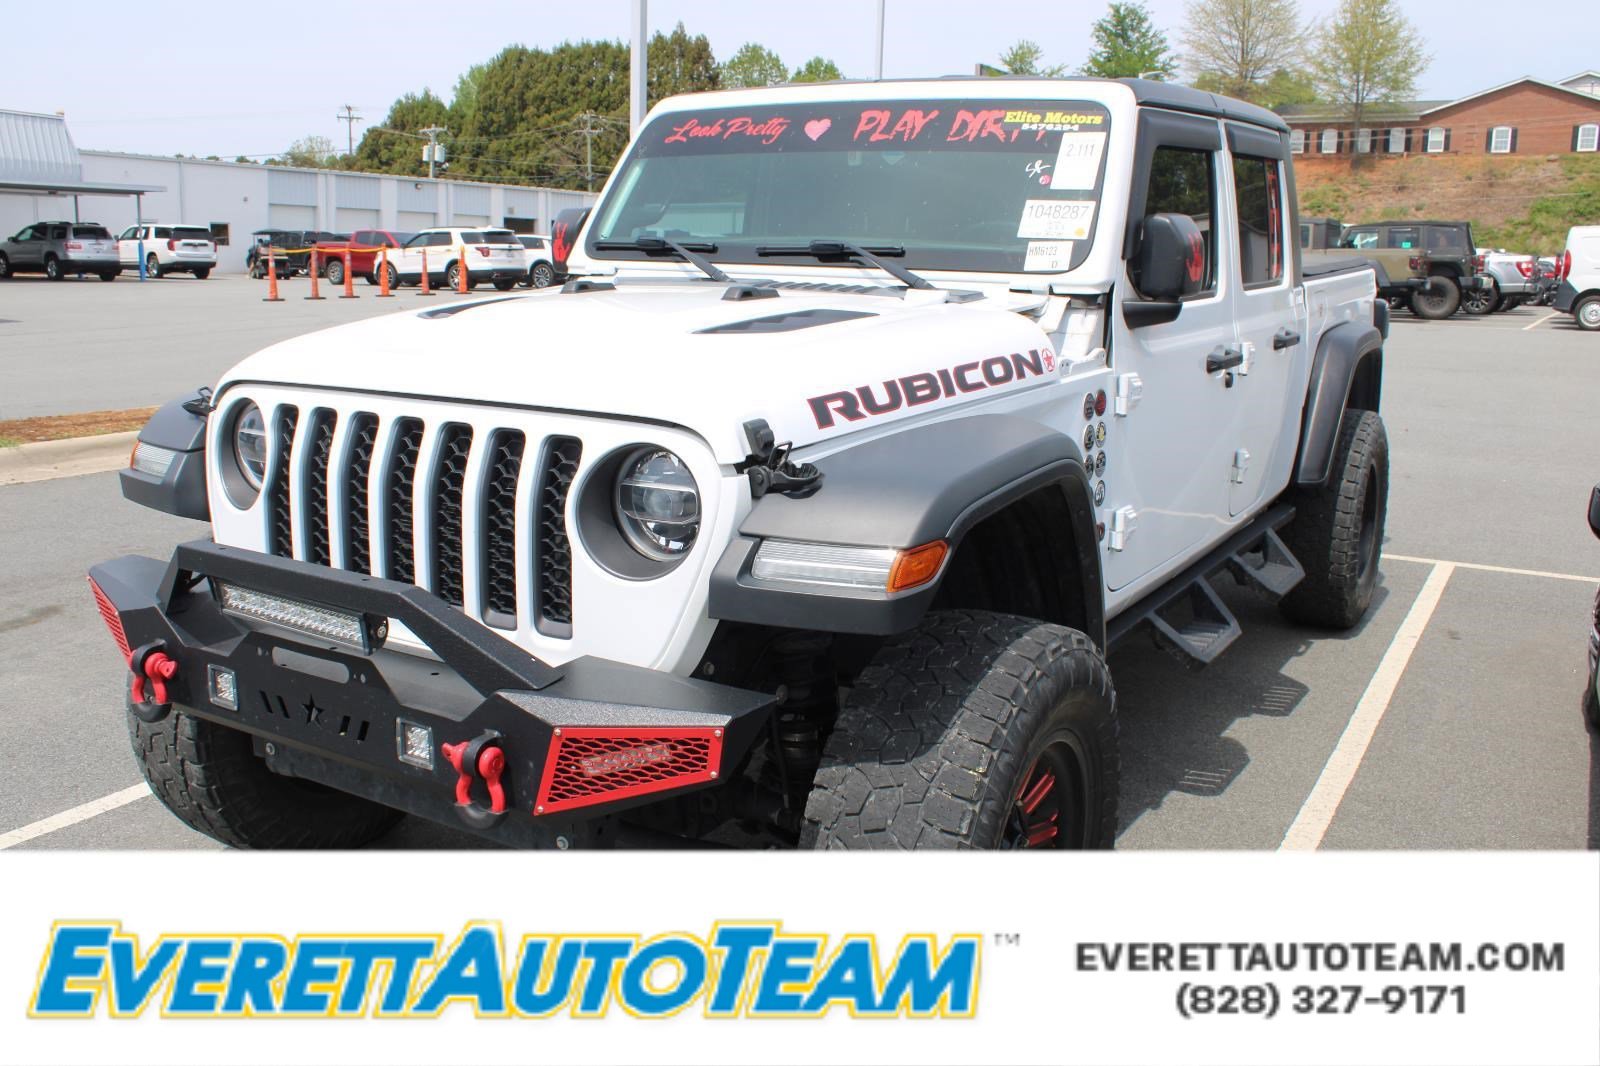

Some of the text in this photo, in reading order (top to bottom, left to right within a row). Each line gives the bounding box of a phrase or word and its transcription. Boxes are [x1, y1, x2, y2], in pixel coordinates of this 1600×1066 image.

[721, 117, 791, 144] Pretty
[853, 109, 939, 142] PLAY
[1004, 110, 1103, 124] Elite Motors
[1028, 204, 1090, 219] 1048287
[807, 349, 1044, 430] RUBICON
